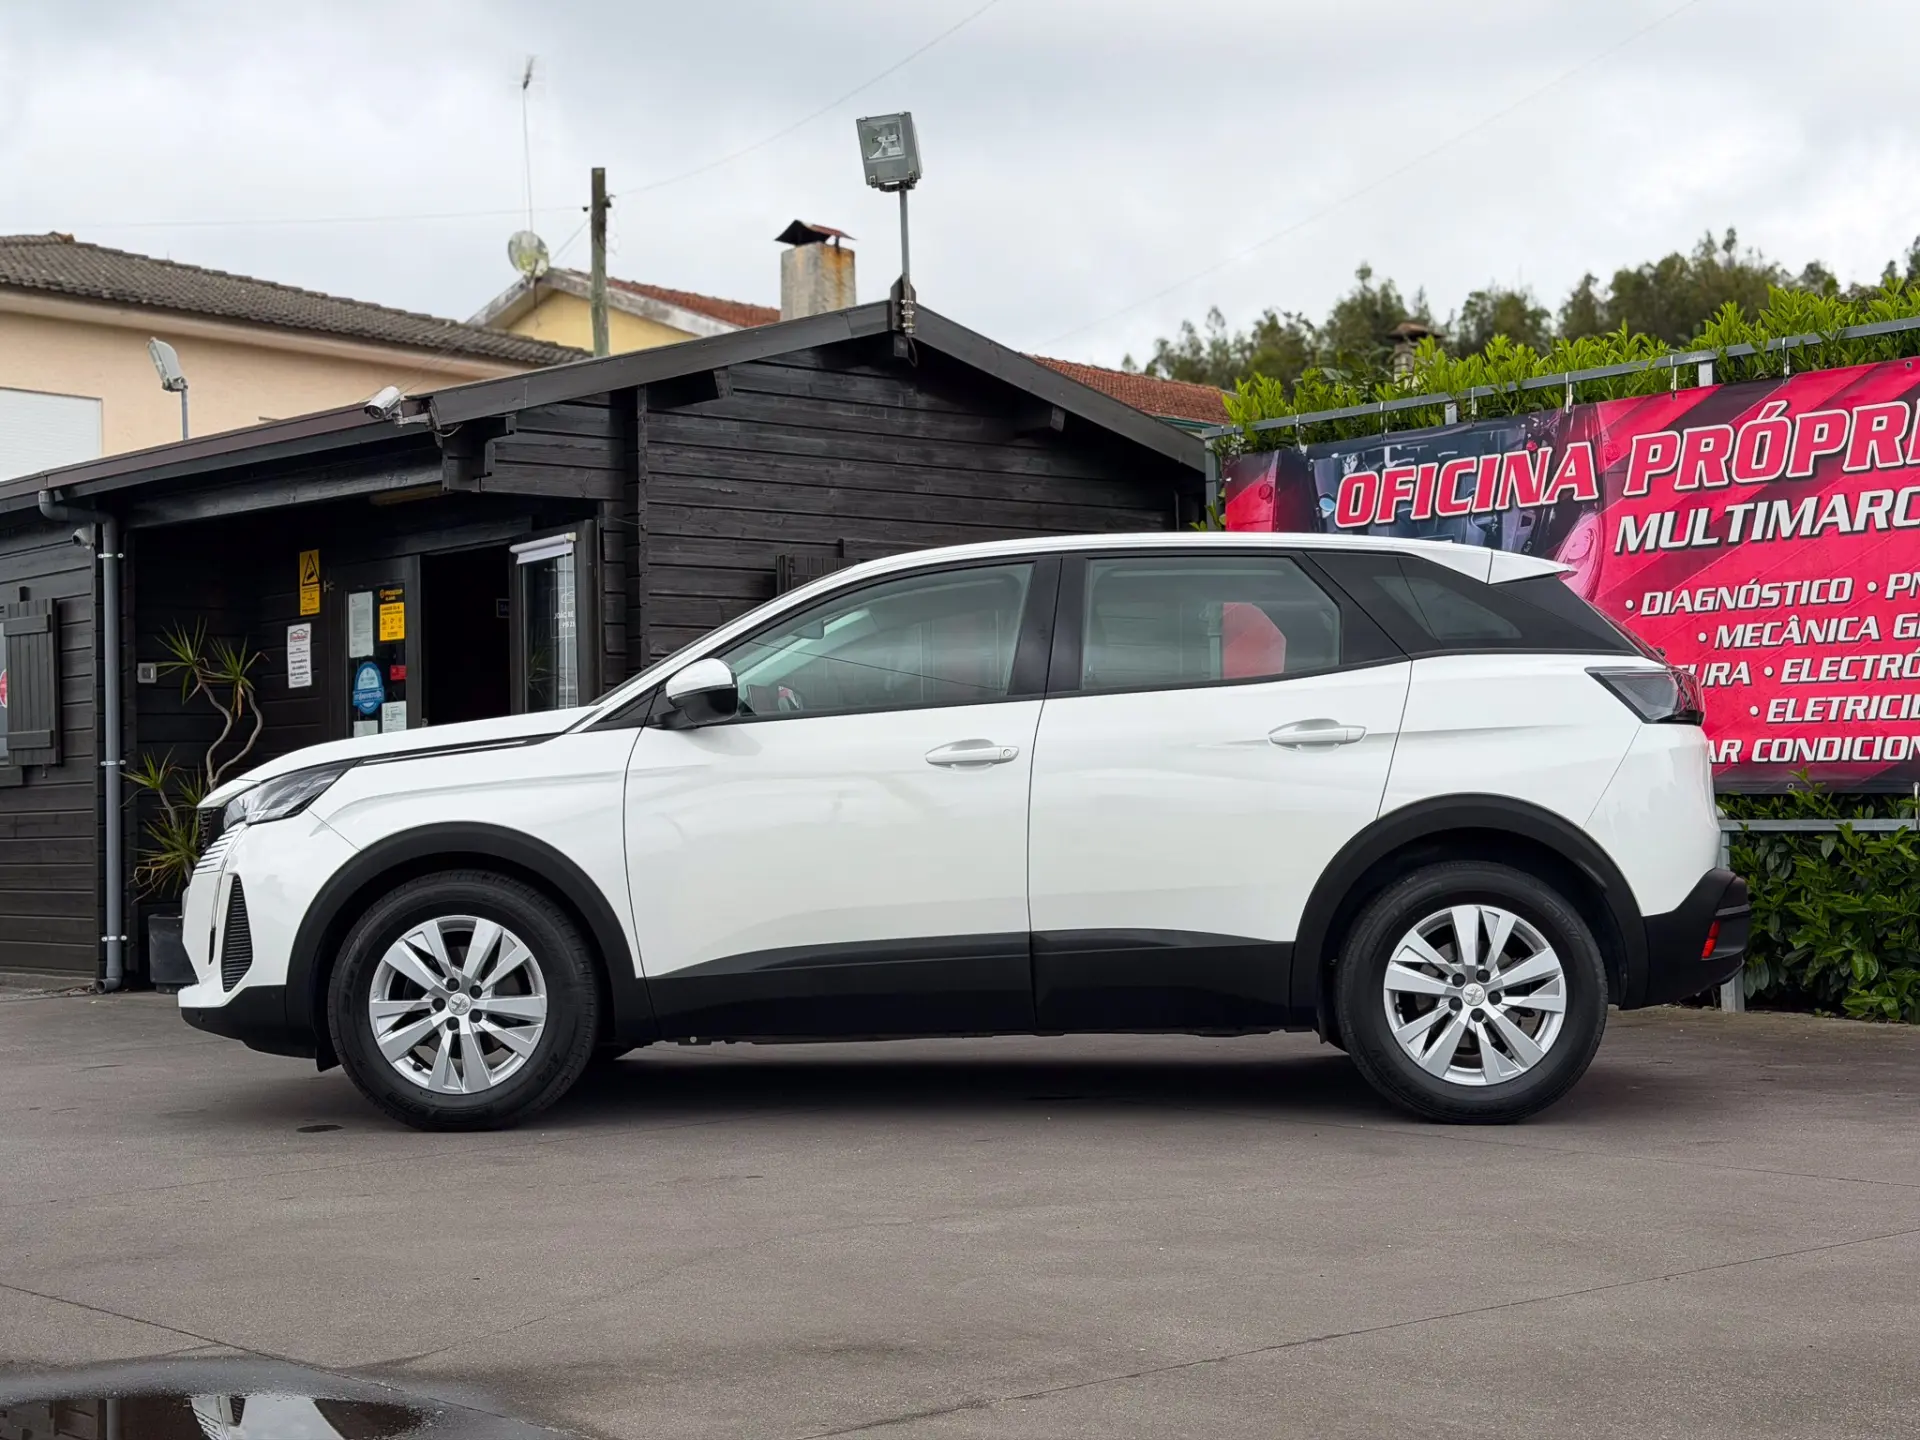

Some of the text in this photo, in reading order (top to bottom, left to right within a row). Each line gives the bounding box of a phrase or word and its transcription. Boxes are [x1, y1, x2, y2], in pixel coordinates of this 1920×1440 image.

[1335, 441, 1599, 528] OFICINA
[1640, 576, 1852, 616] DIAGNÓSTICO
[1714, 612, 1920, 649] MECÂNICA G
